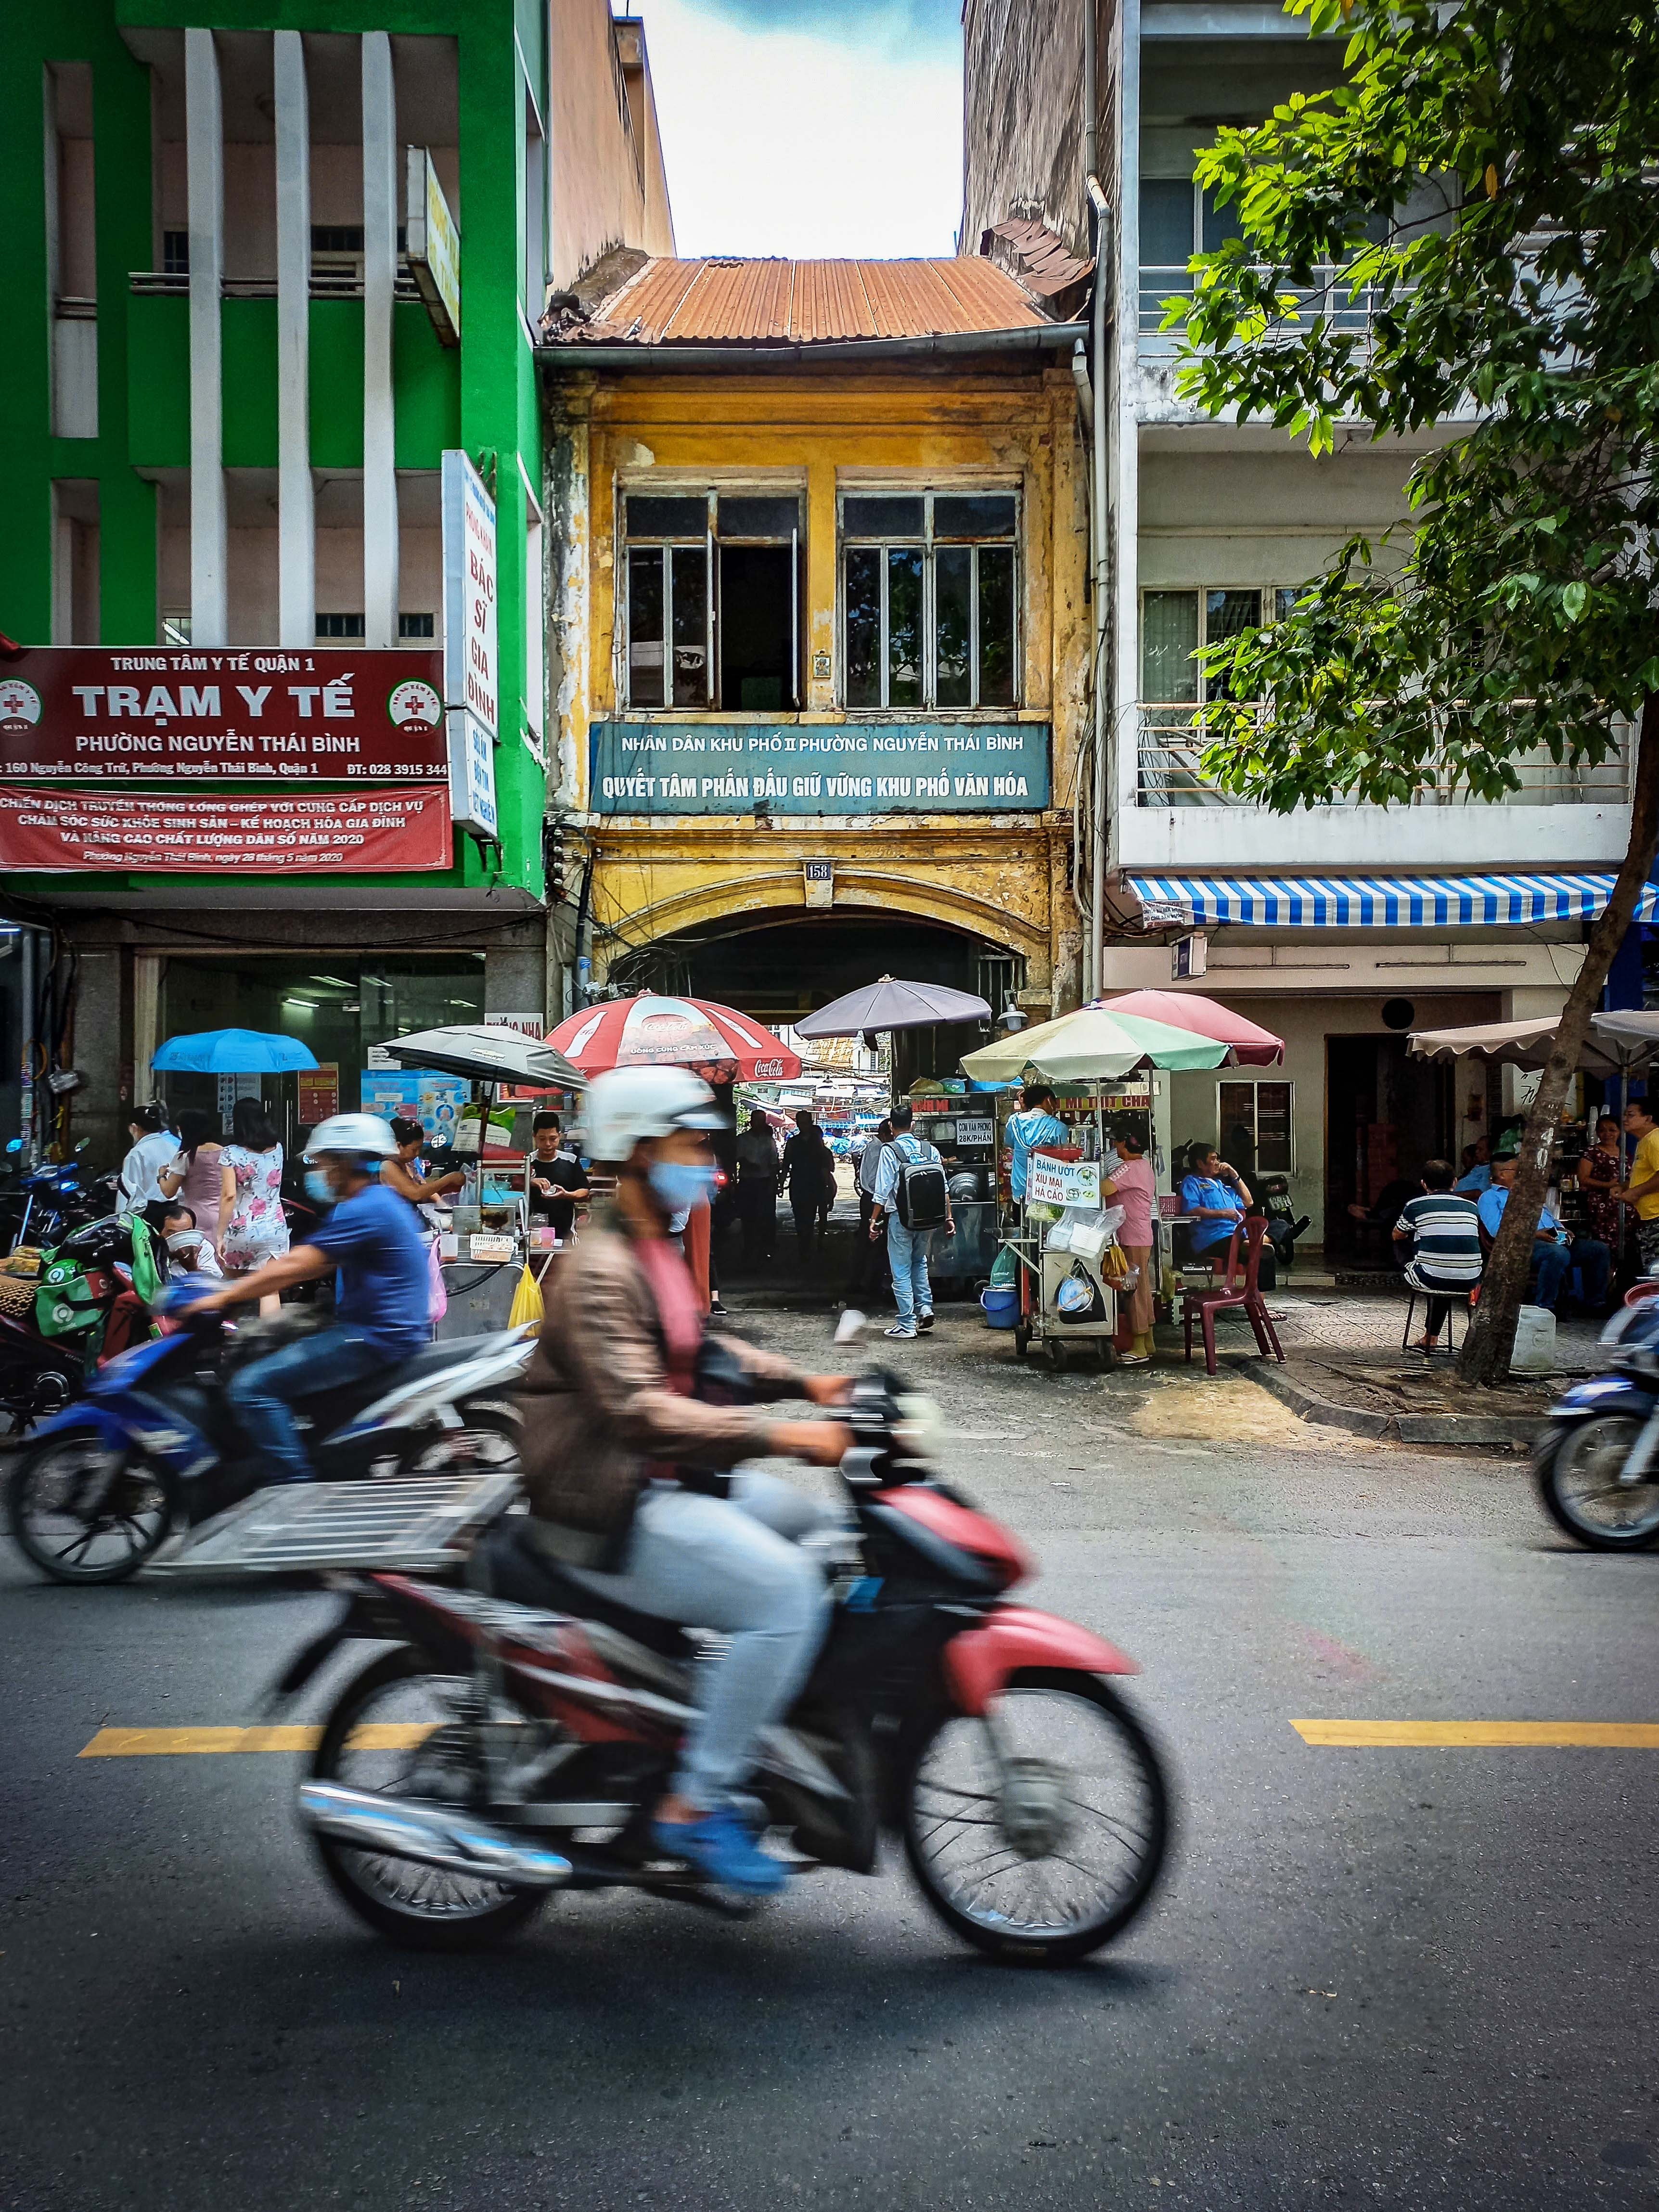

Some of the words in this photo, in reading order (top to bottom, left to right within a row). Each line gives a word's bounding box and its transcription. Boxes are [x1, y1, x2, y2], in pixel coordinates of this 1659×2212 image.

[470, 549, 493, 603] BÁC
[474, 599, 488, 634] SĨ
[110, 657, 167, 670] TRUNG
[170, 654, 207, 670] TÂM
[211, 657, 223, 670] Y
[227, 652, 251, 671] TẾ
[254, 654, 300, 673] QUẬN
[305, 658, 315, 671] 1
[471, 636, 489, 681] GIA
[71, 686, 222, 726] TRẠM
[236, 686, 273, 717] Y
[287, 673, 356, 718] TẾ
[467, 671, 495, 725] ĐÌNH
[76, 732, 163, 752] PHƯỜNG
[168, 729, 254, 752] NGUYỄN
[258, 732, 307, 752] THÁI
[312, 733, 360, 753] BÌNH
[621, 734, 667, 752] NHÂN
[672, 734, 706, 752] DÂN
[709, 737, 744, 752] KHU
[748, 731, 783, 752] PHỐ
[798, 733, 868, 752] PHƯỜNG
[873, 731, 939, 752] NGUYỄN
[943, 733, 980, 751] THÁI
[986, 732, 1024, 751] BÌNH
[5, 762, 28, 773] 160
[30, 761, 72, 775] Nguyễn
[131, 762, 174, 775] Phường
[176, 760, 219, 775] Nguyễn
[219, 762, 245, 773] Thái
[279, 762, 308, 775] Quận
[310, 763, 319, 774] 1
[347, 764, 367, 775] ĐT:
[369, 764, 393, 775] 028
[394, 764, 424, 775] 3915
[602, 767, 656, 799] QUYẾT
[659, 773, 697, 797] TÂM
[701, 767, 749, 798] PHẤN
[752, 767, 789, 797] ĐẤU
[792, 771, 822, 797] GIỮ
[825, 771, 873, 797] VỮNG
[876, 776, 912, 797] KHU
[915, 767, 950, 797] PHỐ
[953, 772, 989, 797] VĂN
[993, 771, 1029, 797] HÓA
[0, 796, 41, 809] CHIẾN
[43, 799, 78, 812] DỊCH
[228, 801, 268, 813] GHÉP
[270, 802, 295, 813] VỚI
[296, 802, 336, 813] CUNG
[338, 798, 367, 813] CẤP
[369, 801, 402, 814] DỊCH
[404, 799, 424, 814] VỤ
[59, 814, 89, 827] SÓC
[90, 815, 120, 828] SỨC
[162, 817, 197, 829] SINH
[240, 815, 261, 829] KẾ
[262, 818, 312, 831] HOẠCH
[313, 815, 343, 829] HÓA
[345, 818, 370, 828] GIA
[371, 816, 406, 828] ĐÌNH
[59, 830, 81, 843] VÀ
[122, 834, 153, 844] CAO
[155, 831, 193, 845] CHẤT
[195, 833, 244, 848] LƯỢNG
[245, 833, 275, 845] DÂN
[276, 831, 297, 845] SỐ
[298, 833, 331, 845] NĂM
[332, 834, 365, 845] 2020
[214, 854, 242, 864] ngày
[256, 853, 285, 864] tháng
[286, 853, 293, 862] 5
[295, 854, 318, 862] năm
[318, 853, 344, 862] 2020
[810, 865, 827, 878] 158
[1036, 1158, 1056, 1173] BÁNH
[1058, 1165, 1075, 1177] ƯỚT
[1035, 1172, 1047, 1184] XÍU
[1049, 1176, 1063, 1190] MẠI
[1035, 1185, 1045, 1198] HÁ
[1047, 1188, 1064, 1201] CẢO
